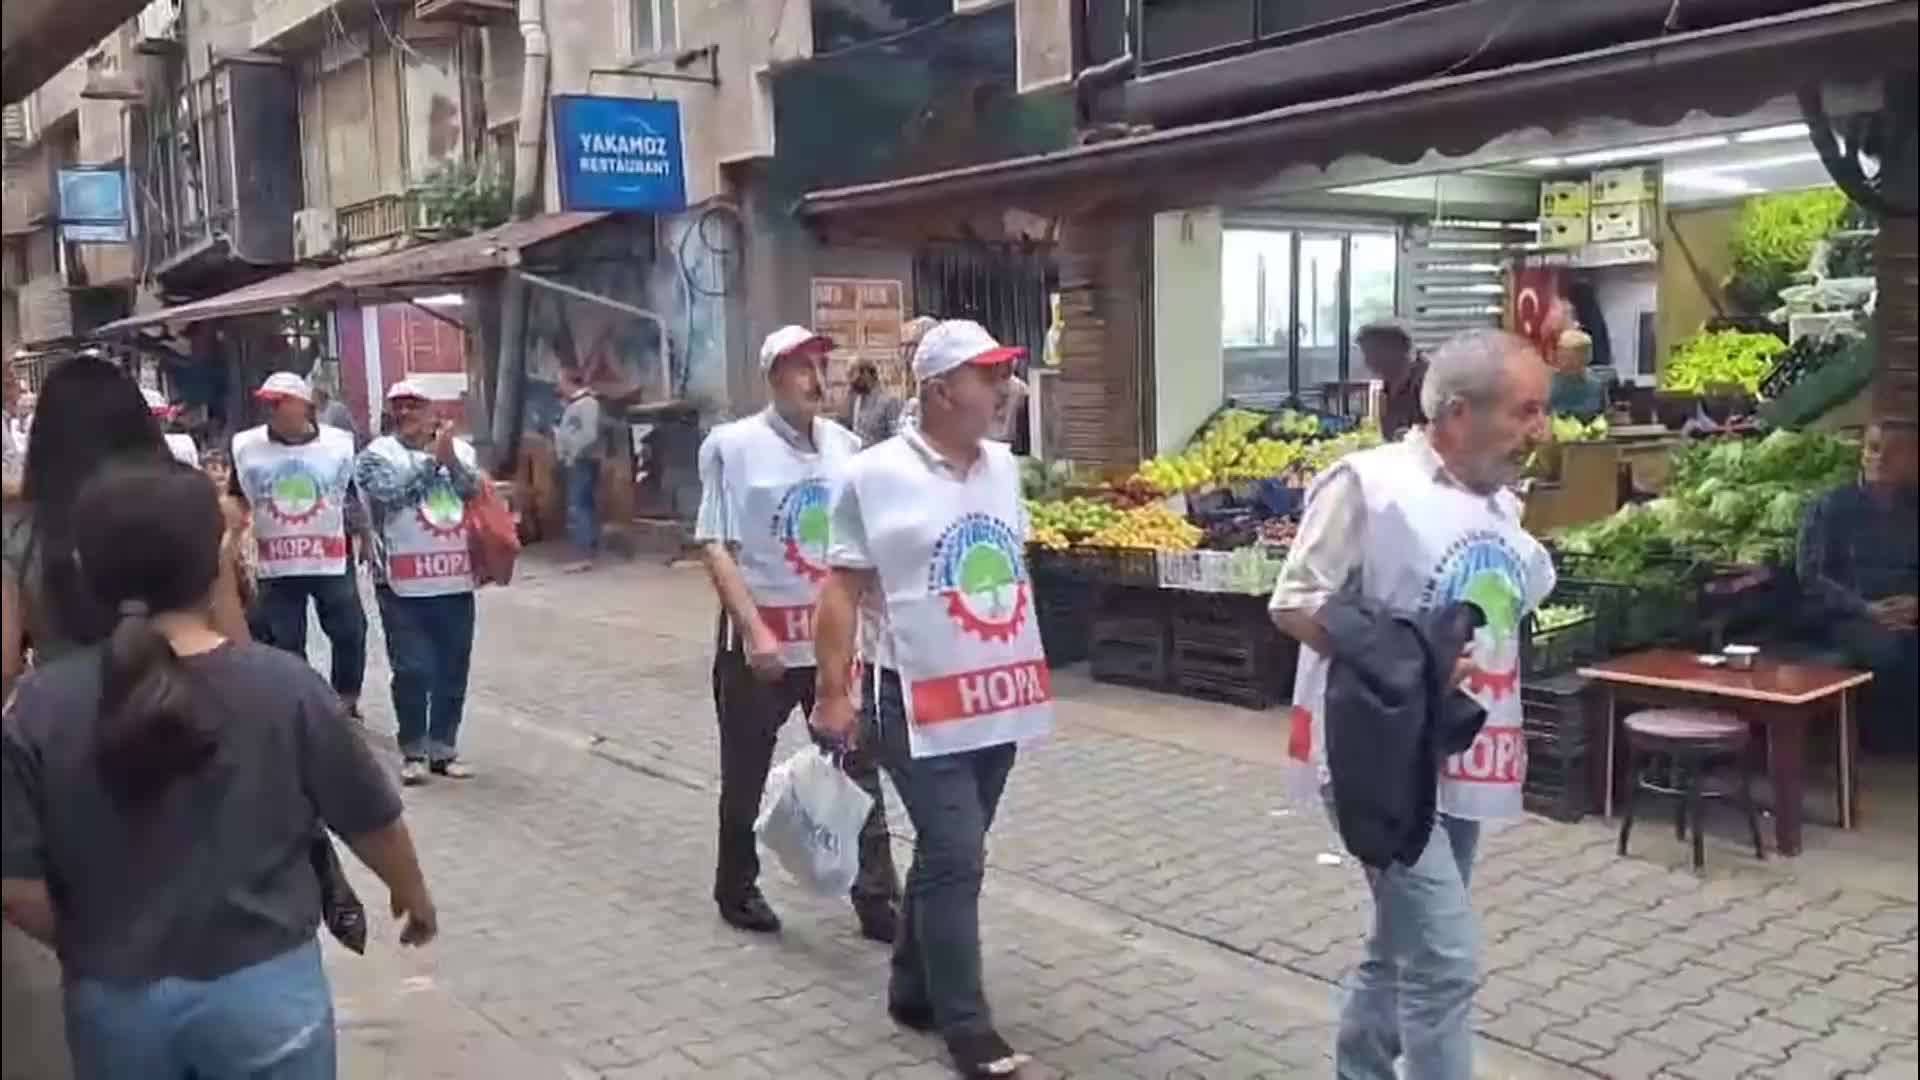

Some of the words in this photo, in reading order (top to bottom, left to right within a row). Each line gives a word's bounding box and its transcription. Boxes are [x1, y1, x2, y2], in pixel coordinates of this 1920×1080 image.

[579, 133, 667, 156] YAKAMOZ
[579, 156, 670, 176] RESTAURANT
[269, 537, 325, 560] HOPA
[958, 664, 1046, 713] HOPA
